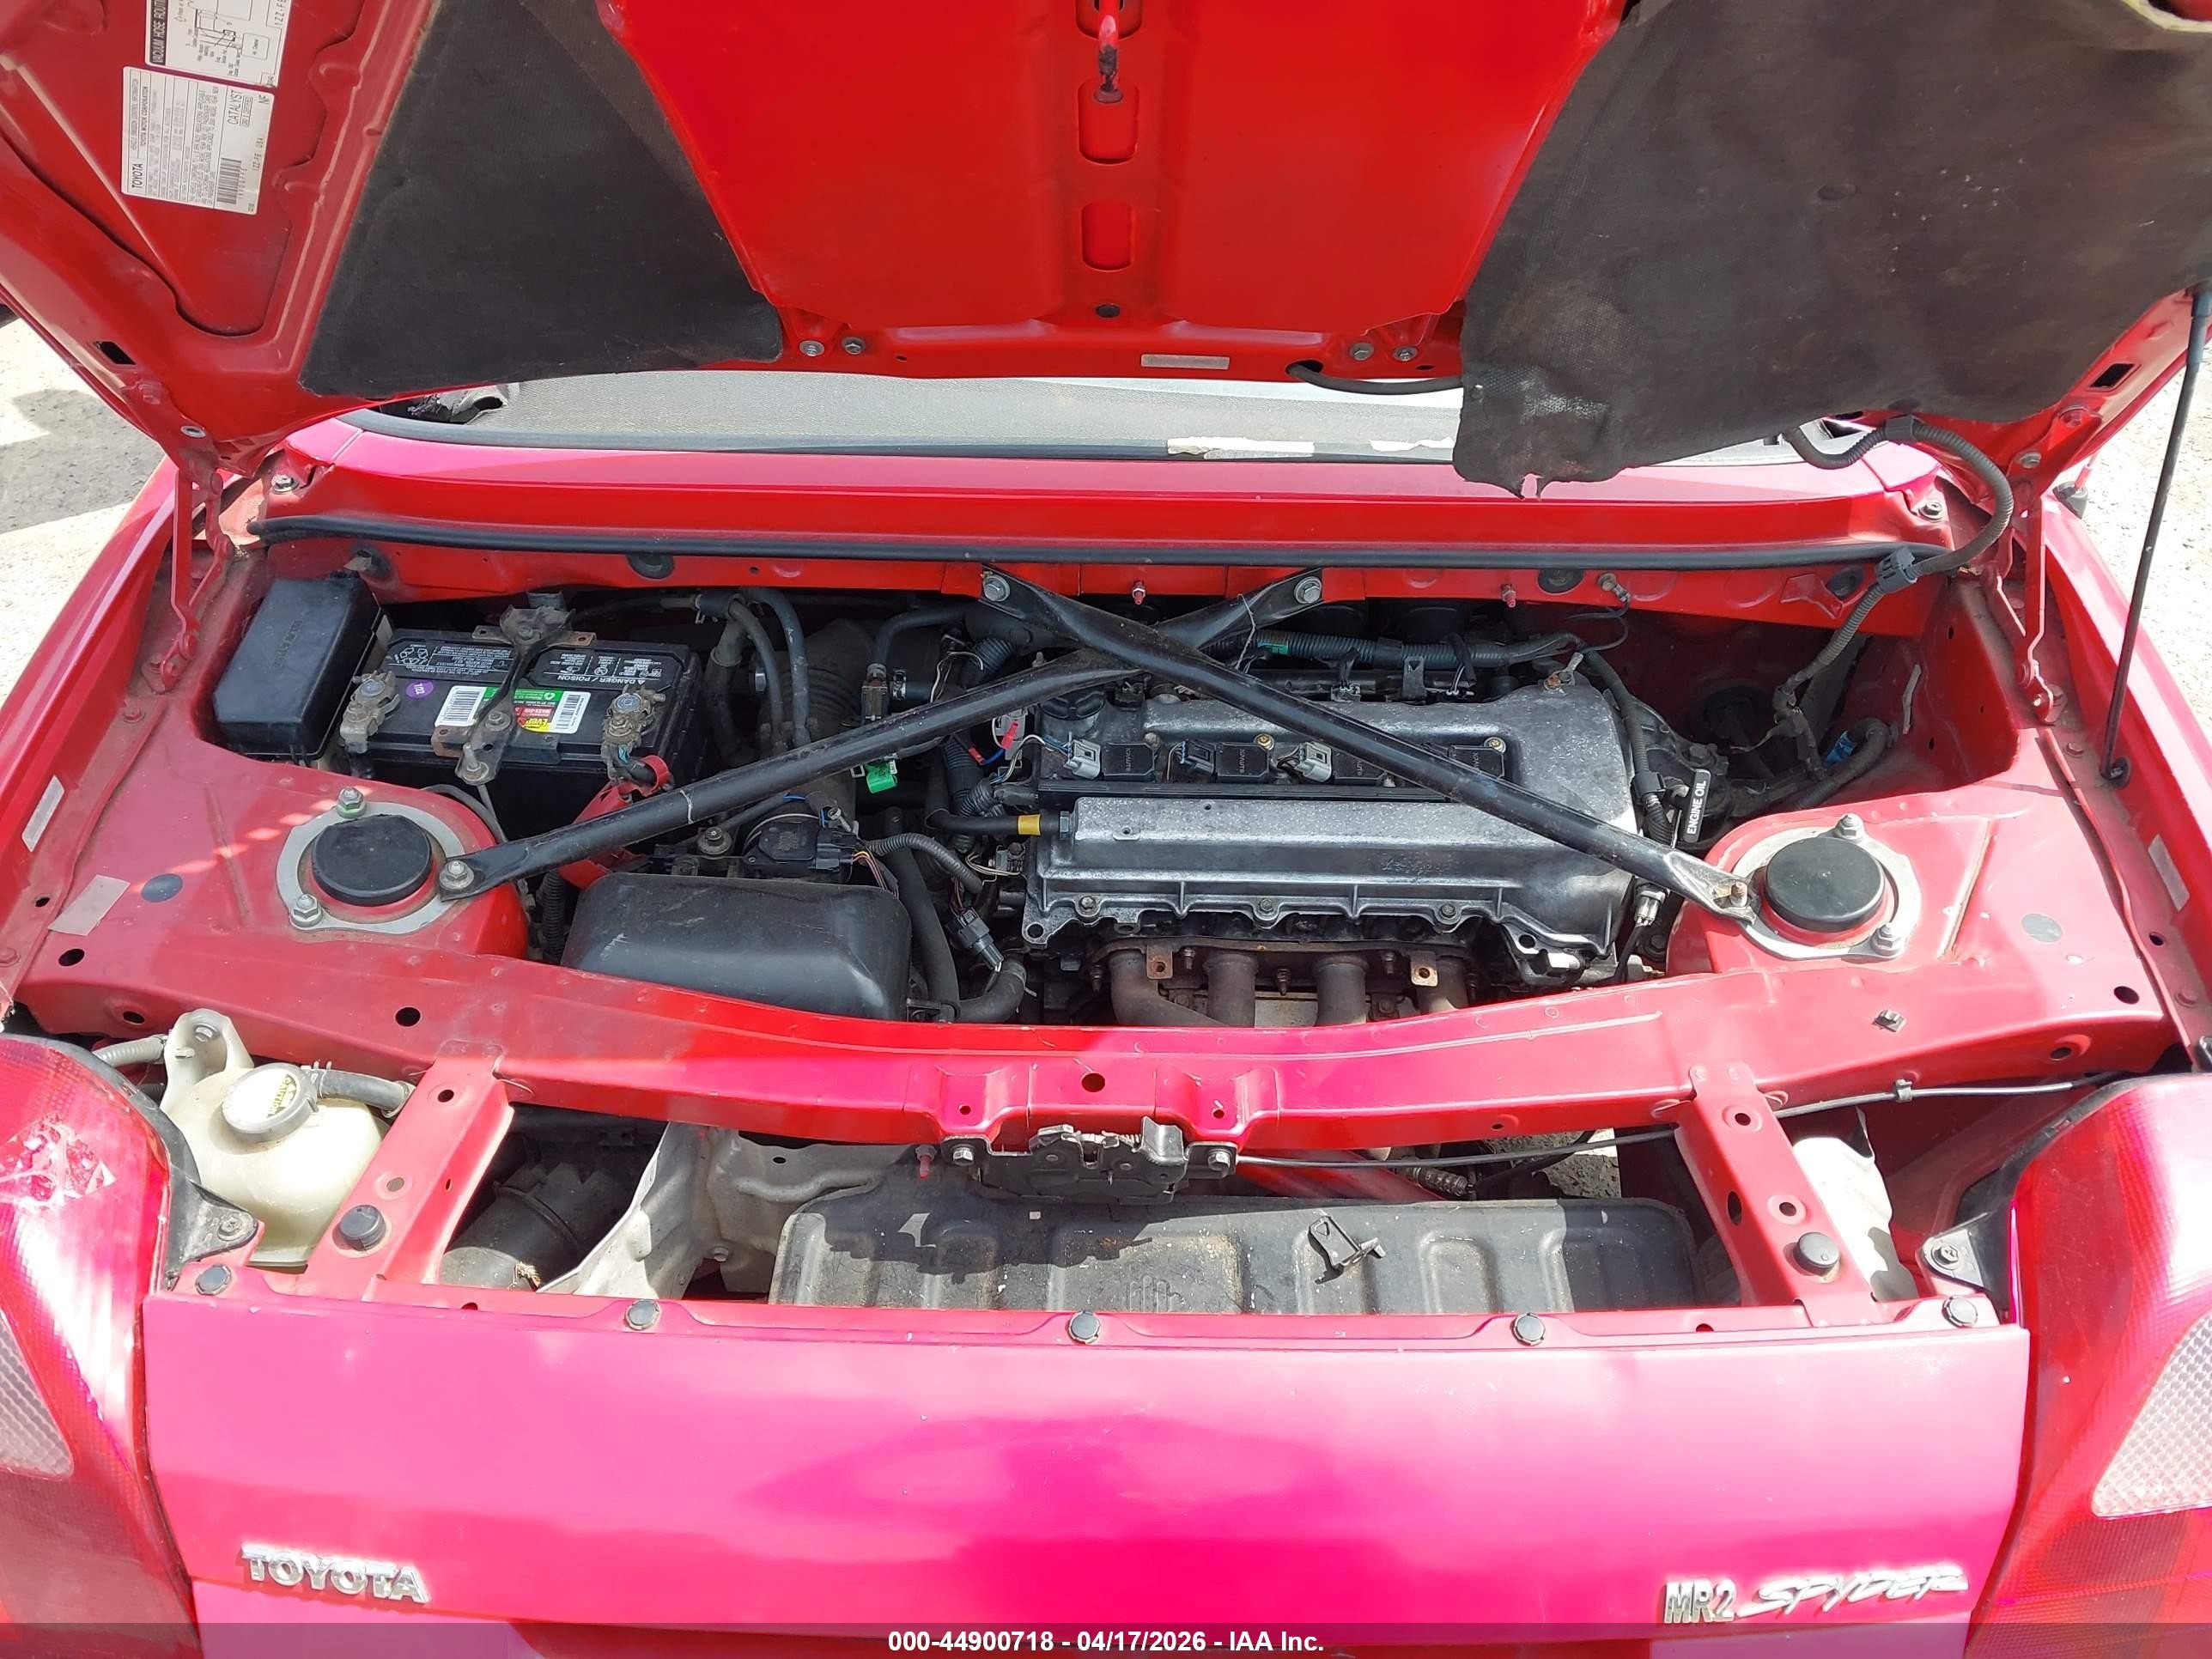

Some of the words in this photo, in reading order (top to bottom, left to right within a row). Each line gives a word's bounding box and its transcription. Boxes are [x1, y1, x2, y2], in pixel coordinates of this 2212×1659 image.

[153, 21, 165, 38] HOSE
[227, 89, 242, 125] CATALYST
[131, 163, 143, 188] TOYOTA
[1694, 781, 1707, 797] OIL
[1686, 798, 1704, 835] ENGINE
[269, 1077, 292, 1115] CAUTION
[241, 1542, 432, 1605] TOYOTA
[1663, 1578, 1738, 1624] MR2
[1736, 1563, 1970, 1618] SPYDER
